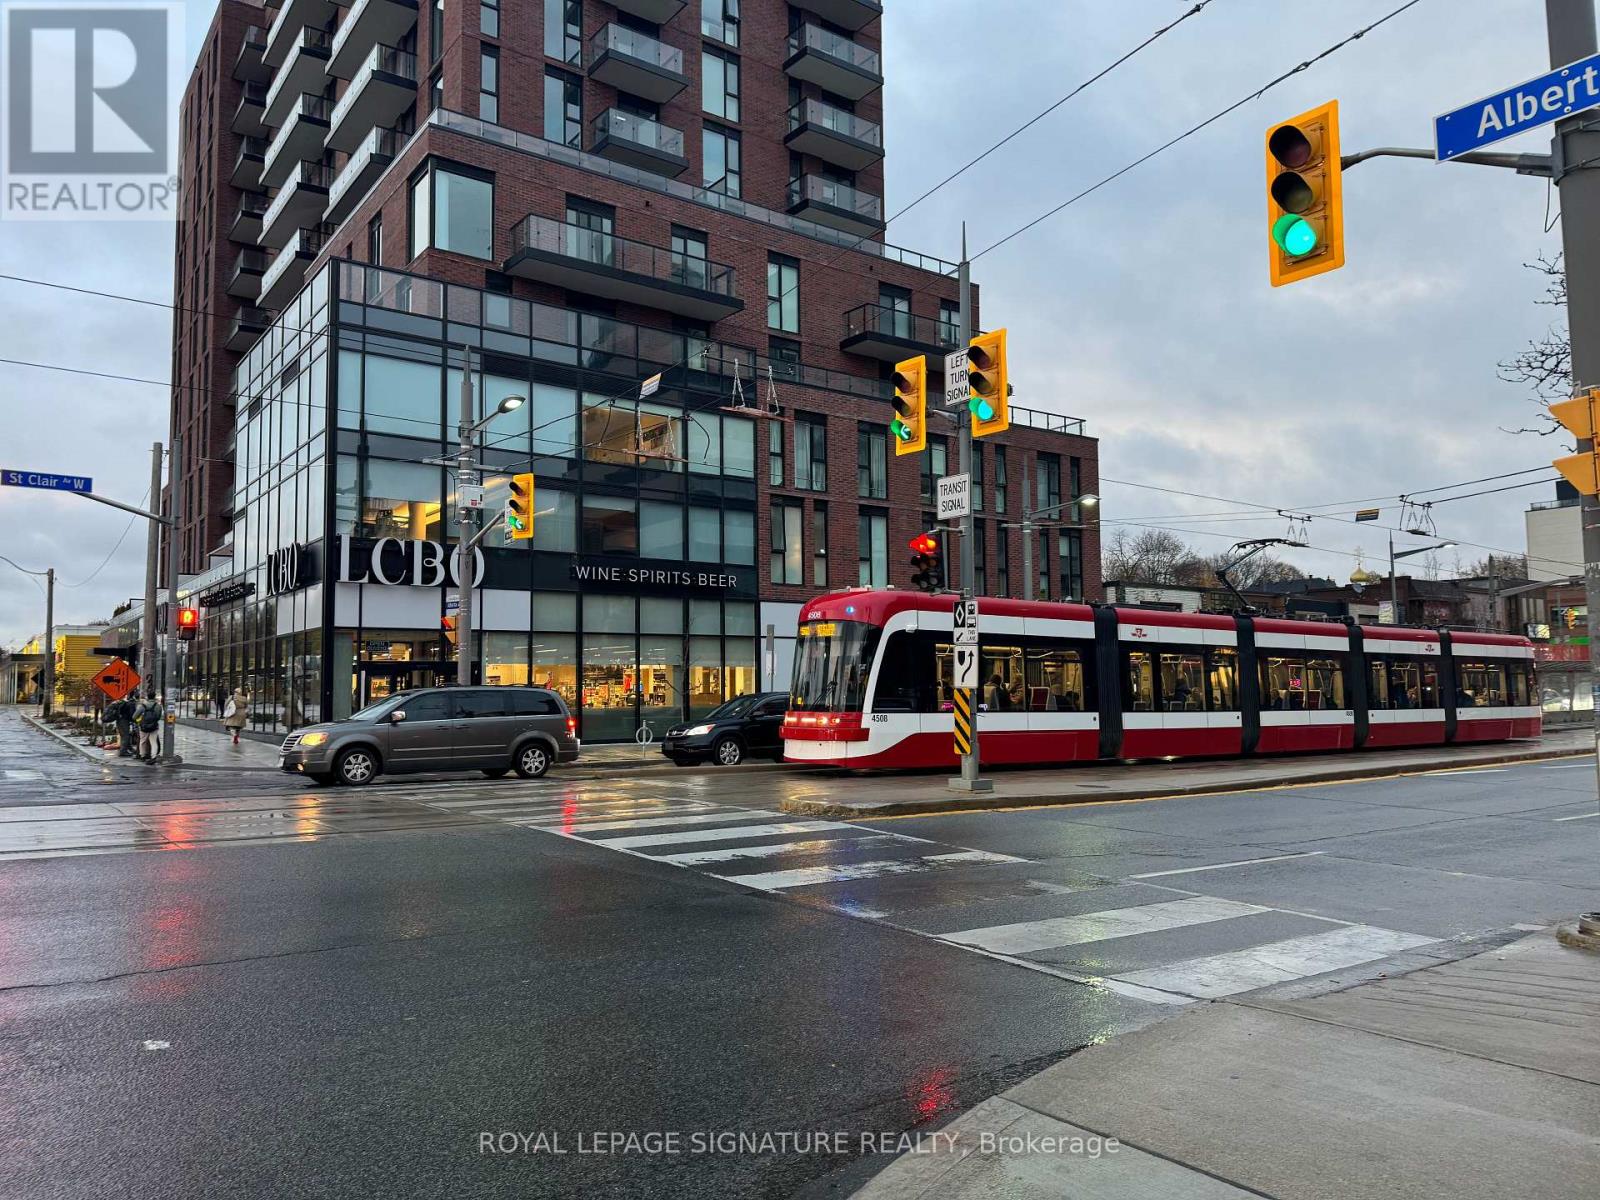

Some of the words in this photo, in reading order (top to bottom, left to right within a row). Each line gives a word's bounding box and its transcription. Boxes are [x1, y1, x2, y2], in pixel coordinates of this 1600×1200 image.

[1477, 66, 1600, 138] Albert
[951, 353, 968, 369] LEFT
[9, 472, 24, 484] St
[28, 474, 59, 487] Clair
[73, 478, 85, 490] W
[940, 480, 967, 497] TRANSIT
[941, 498, 966, 513] SIGNAL
[336, 533, 485, 589] LCBO
[698, 573, 737, 588] BEER
[871, 714, 888, 723] 4508
